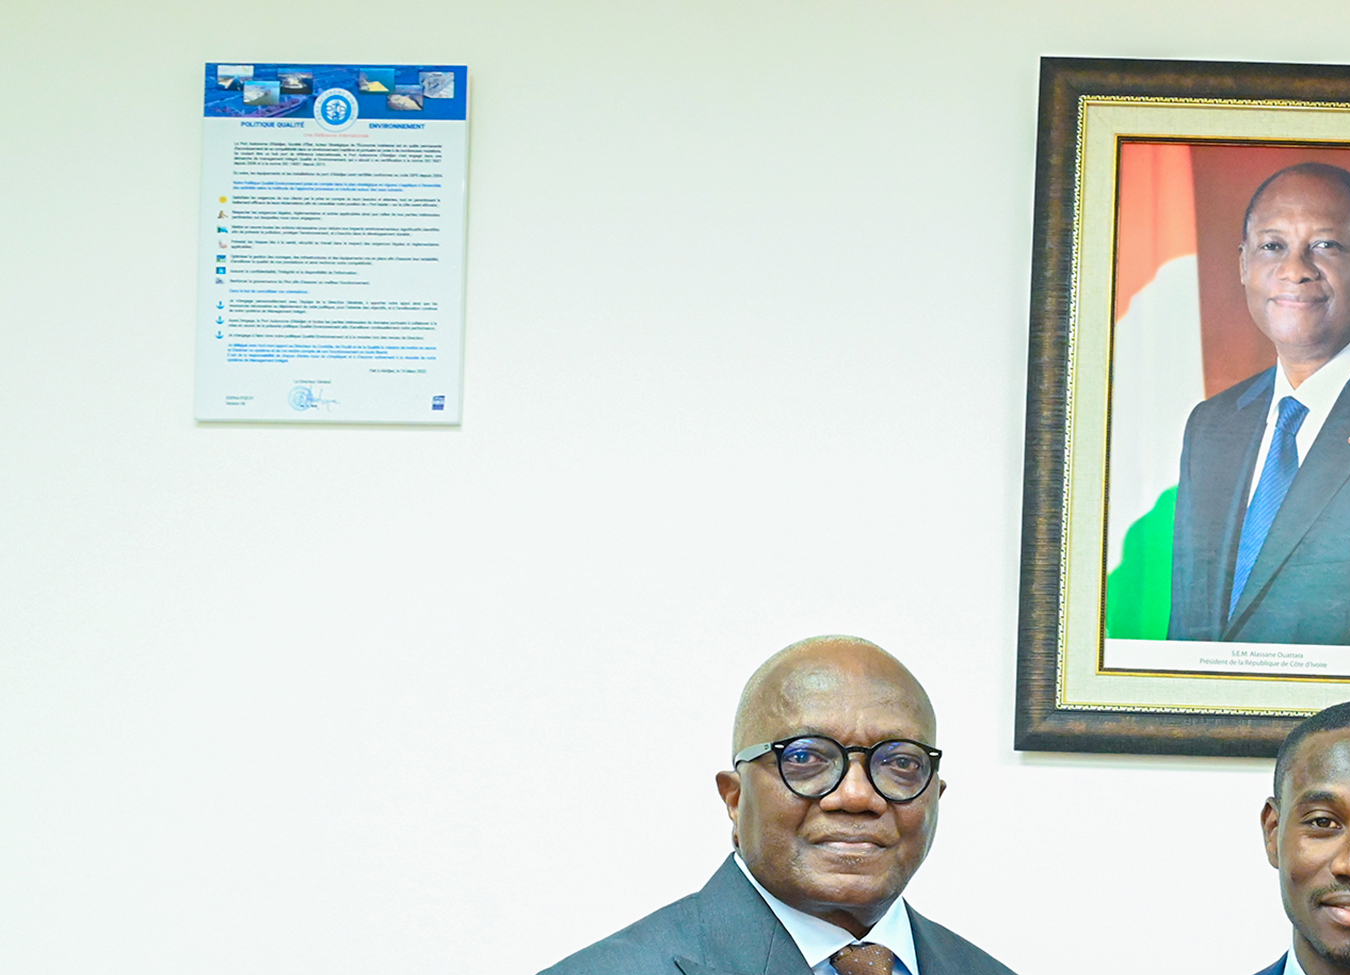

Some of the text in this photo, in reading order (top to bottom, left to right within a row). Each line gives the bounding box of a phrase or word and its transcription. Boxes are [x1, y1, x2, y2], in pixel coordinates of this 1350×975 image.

[368, 122, 425, 130] ENVIRONNEMENT
[1277, 651, 1304, 659] Ouattara
[1198, 658, 1229, 666] Président
[1244, 659, 1280, 668] République
[1289, 660, 1305, 668] Côte
[1304, 661, 1328, 669] d'Ivoire
